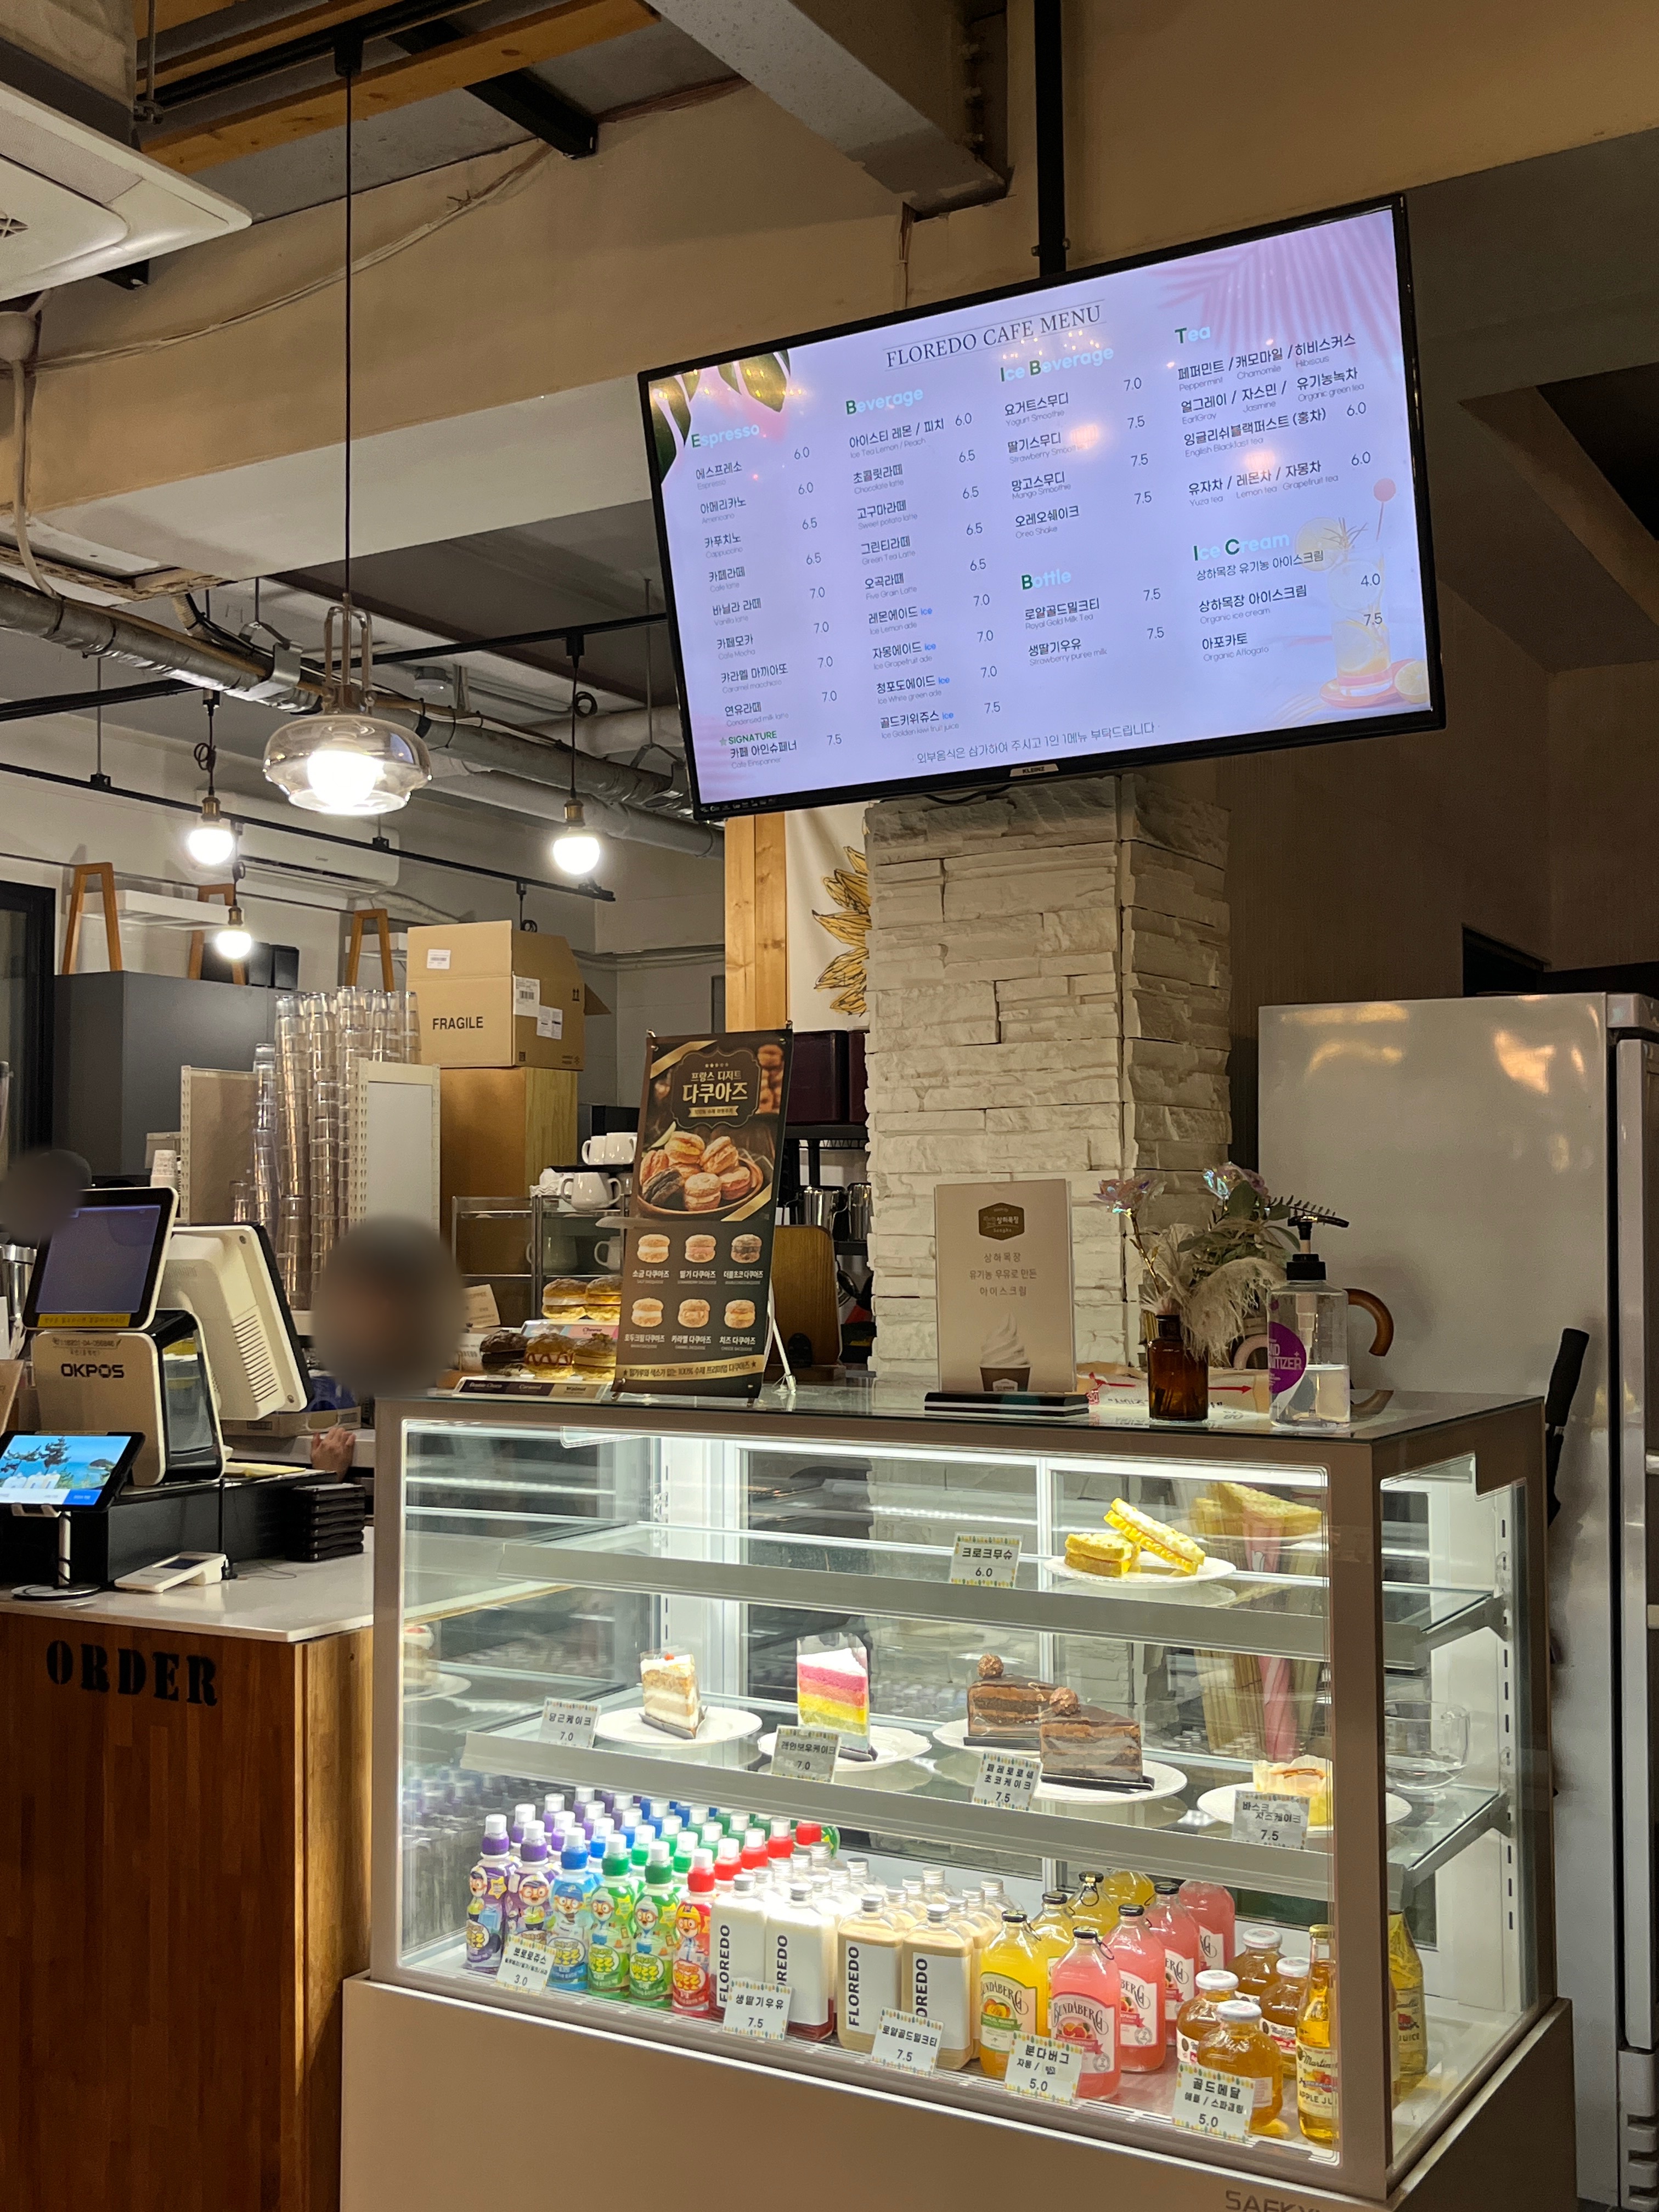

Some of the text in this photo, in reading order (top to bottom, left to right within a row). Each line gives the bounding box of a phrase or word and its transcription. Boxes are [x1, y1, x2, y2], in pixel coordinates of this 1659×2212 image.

[886, 305, 1101, 368] FLOREDO CAFE MENU
[1175, 326, 1210, 344] Tea
[1178, 332, 1356, 380] 페퍼민트 캐모마일 히비스커스
[1000, 348, 1114, 383] Ice Beverage
[1123, 377, 1142, 391] 7.0
[1181, 366, 1358, 414] 얼그레이 자스민 유기농녹차
[846, 388, 923, 415] Beverage
[1005, 391, 1069, 417] 요거트스무디
[1347, 401, 1367, 417] 6.0
[955, 412, 972, 426] 6.0
[1127, 415, 1146, 430] 7.5
[692, 425, 760, 448] Espresso
[849, 417, 944, 448] 아이스티 레몬 피치
[1008, 431, 1061, 453] 딸기스무디
[794, 447, 810, 460] 6.0
[959, 449, 976, 463] 6.5
[1131, 453, 1149, 467] 7.5
[1351, 451, 1371, 466] 6.0
[696, 461, 743, 479] 에스프레소
[1011, 471, 1065, 492] 망고스무디
[1188, 460, 1322, 496] 유자차 레몬차 자몽차
[798, 482, 814, 494] 6.0
[962, 486, 979, 499] 6.5
[700, 496, 746, 514] 아메리카노
[1134, 490, 1152, 505] 7.5
[857, 499, 907, 520] 고구마라떼
[1015, 505, 1080, 528] 오레오쉐이크
[802, 517, 817, 530] 6.5
[966, 522, 983, 536] 6.5
[704, 532, 742, 548] 카푸치노
[860, 535, 911, 555] 그린티라떼
[1193, 533, 1290, 561] Ice Cream
[806, 552, 821, 565] 6.5
[969, 558, 986, 571] 6.5
[1196, 549, 1324, 582] 상하목장 유기농 아이스크림
[865, 572, 904, 590] 오곡라떼
[1021, 568, 1071, 590] Bottle
[1361, 573, 1380, 587] 4.0
[809, 586, 825, 599] 7.0
[1143, 588, 1161, 601] 7.5
[1199, 584, 1307, 613] 상하목장 아이스크림
[973, 594, 990, 607] 7.0
[713, 601, 740, 616] 바닐라
[868, 606, 918, 625] 레몬에이드
[1025, 597, 1100, 621] 로얄골드밀크티
[1363, 612, 1383, 627] 7.5
[814, 621, 829, 634] 7.0
[1147, 627, 1164, 640] 7.5
[716, 634, 753, 650] 카페모카
[977, 629, 994, 643] 7.0
[1202, 632, 1248, 651] 아포카토
[872, 641, 922, 659] 자몽에이드
[1028, 638, 1082, 657] 생딸기우유
[817, 656, 833, 669] 7.0
[751, 663, 788, 679] 마끼아또
[980, 665, 997, 679] 7.0
[876, 675, 936, 695] 청포도에이드
[822, 690, 837, 702] 7.0
[725, 702, 761, 717] 연유라떼
[984, 701, 1001, 714] 7.5
[728, 730, 777, 744] SIGNATURE
[826, 734, 842, 746] 7.5
[917, 747, 966, 764] 외부음식은
[1011, 737, 1041, 752] 주시고
[1091, 721, 1154, 740] 부탁드립니다
[730, 740, 797, 759] 카페 아인슈페너
[432, 1016, 483, 1030] FRAGILE
[691, 1071, 715, 1082] 프랑스
[682, 1082, 748, 1104] 다쿠아즈
[969, 1269, 992, 1280] 유기농
[980, 1286, 1027, 1296] 아이스크림
[61, 1363, 125, 1378] OKPOS
[962, 1547, 1013, 1560] 크로크무슈
[975, 1567, 993, 1577] 6.0
[46, 1639, 218, 1707] ORDER
[560, 1731, 573, 1741] 7.0
[797, 1760, 811, 1770] 7.0
[984, 1774, 1031, 1790] 초코케이크
[996, 1791, 1011, 1803] 7.5
[1243, 1801, 1269, 1812] 바스크
[1255, 1812, 1301, 1824] 치즈케이크
[1261, 1829, 1279, 1841] 7.5
[719, 1924, 730, 2002] FLOREDO
[514, 1974, 528, 1986] 3.0
[848, 1946, 860, 2027] FLOREDO
[916, 1958, 928, 2018] OREDO
[736, 1994, 783, 2010] 생딸기우유
[748, 2017, 764, 2028] 7.5
[882, 2024, 938, 2047] 로얄골드밀크티
[896, 2049, 913, 2062] 7.5
[1025, 2044, 1069, 2064] 분다버그
[1017, 2058, 1032, 2069] 자몽
[1029, 2078, 1048, 2091] 5.0
[1193, 2077, 1240, 2100] 골드메달
[1199, 2113, 1218, 2128] 5.0
